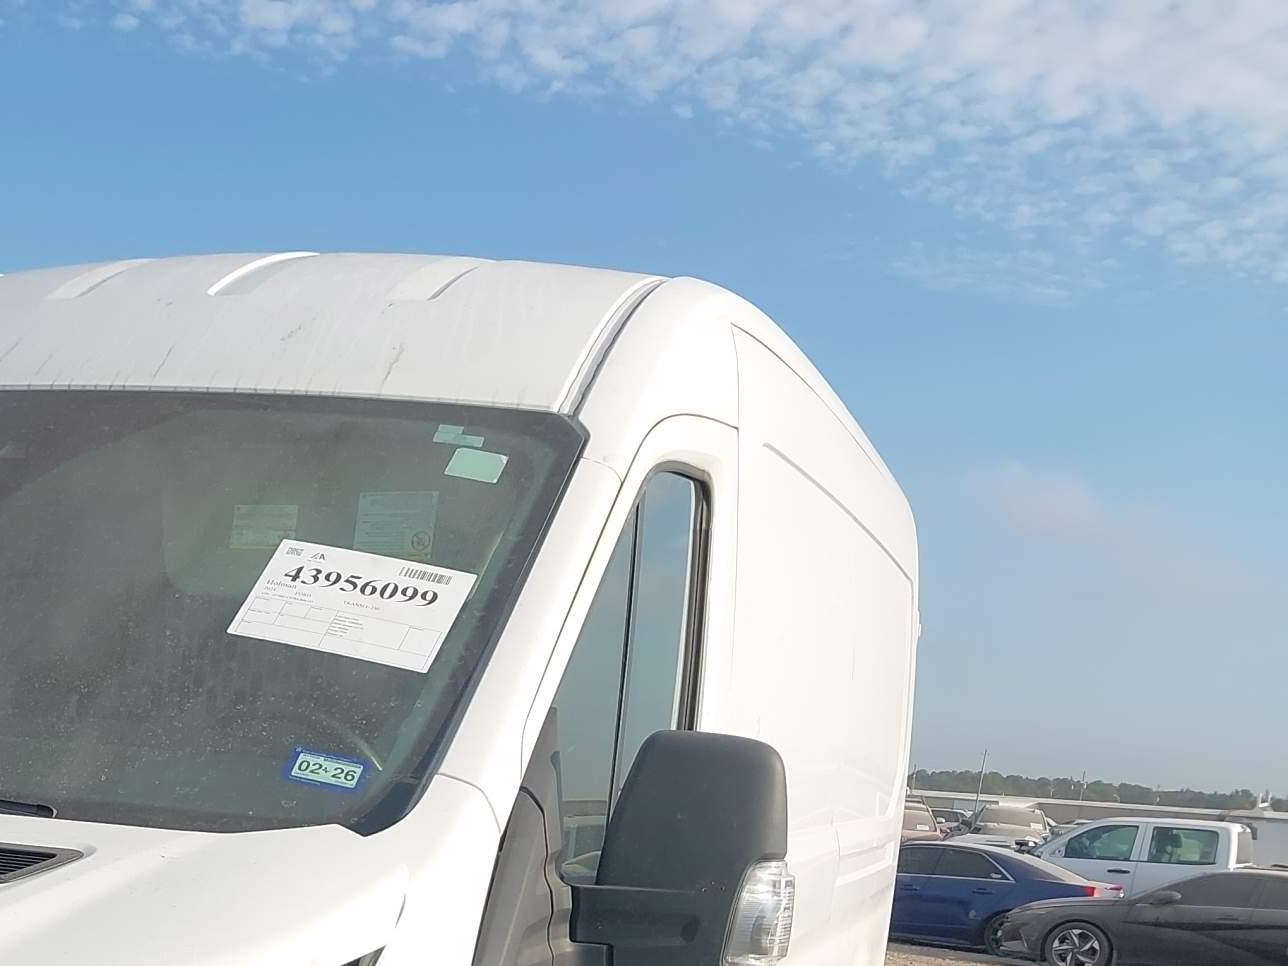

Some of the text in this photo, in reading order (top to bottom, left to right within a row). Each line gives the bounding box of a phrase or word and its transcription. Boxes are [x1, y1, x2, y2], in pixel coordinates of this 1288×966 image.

[284, 565, 440, 608] 43956099
[297, 760, 323, 775] 02
[331, 767, 357, 781] 26
